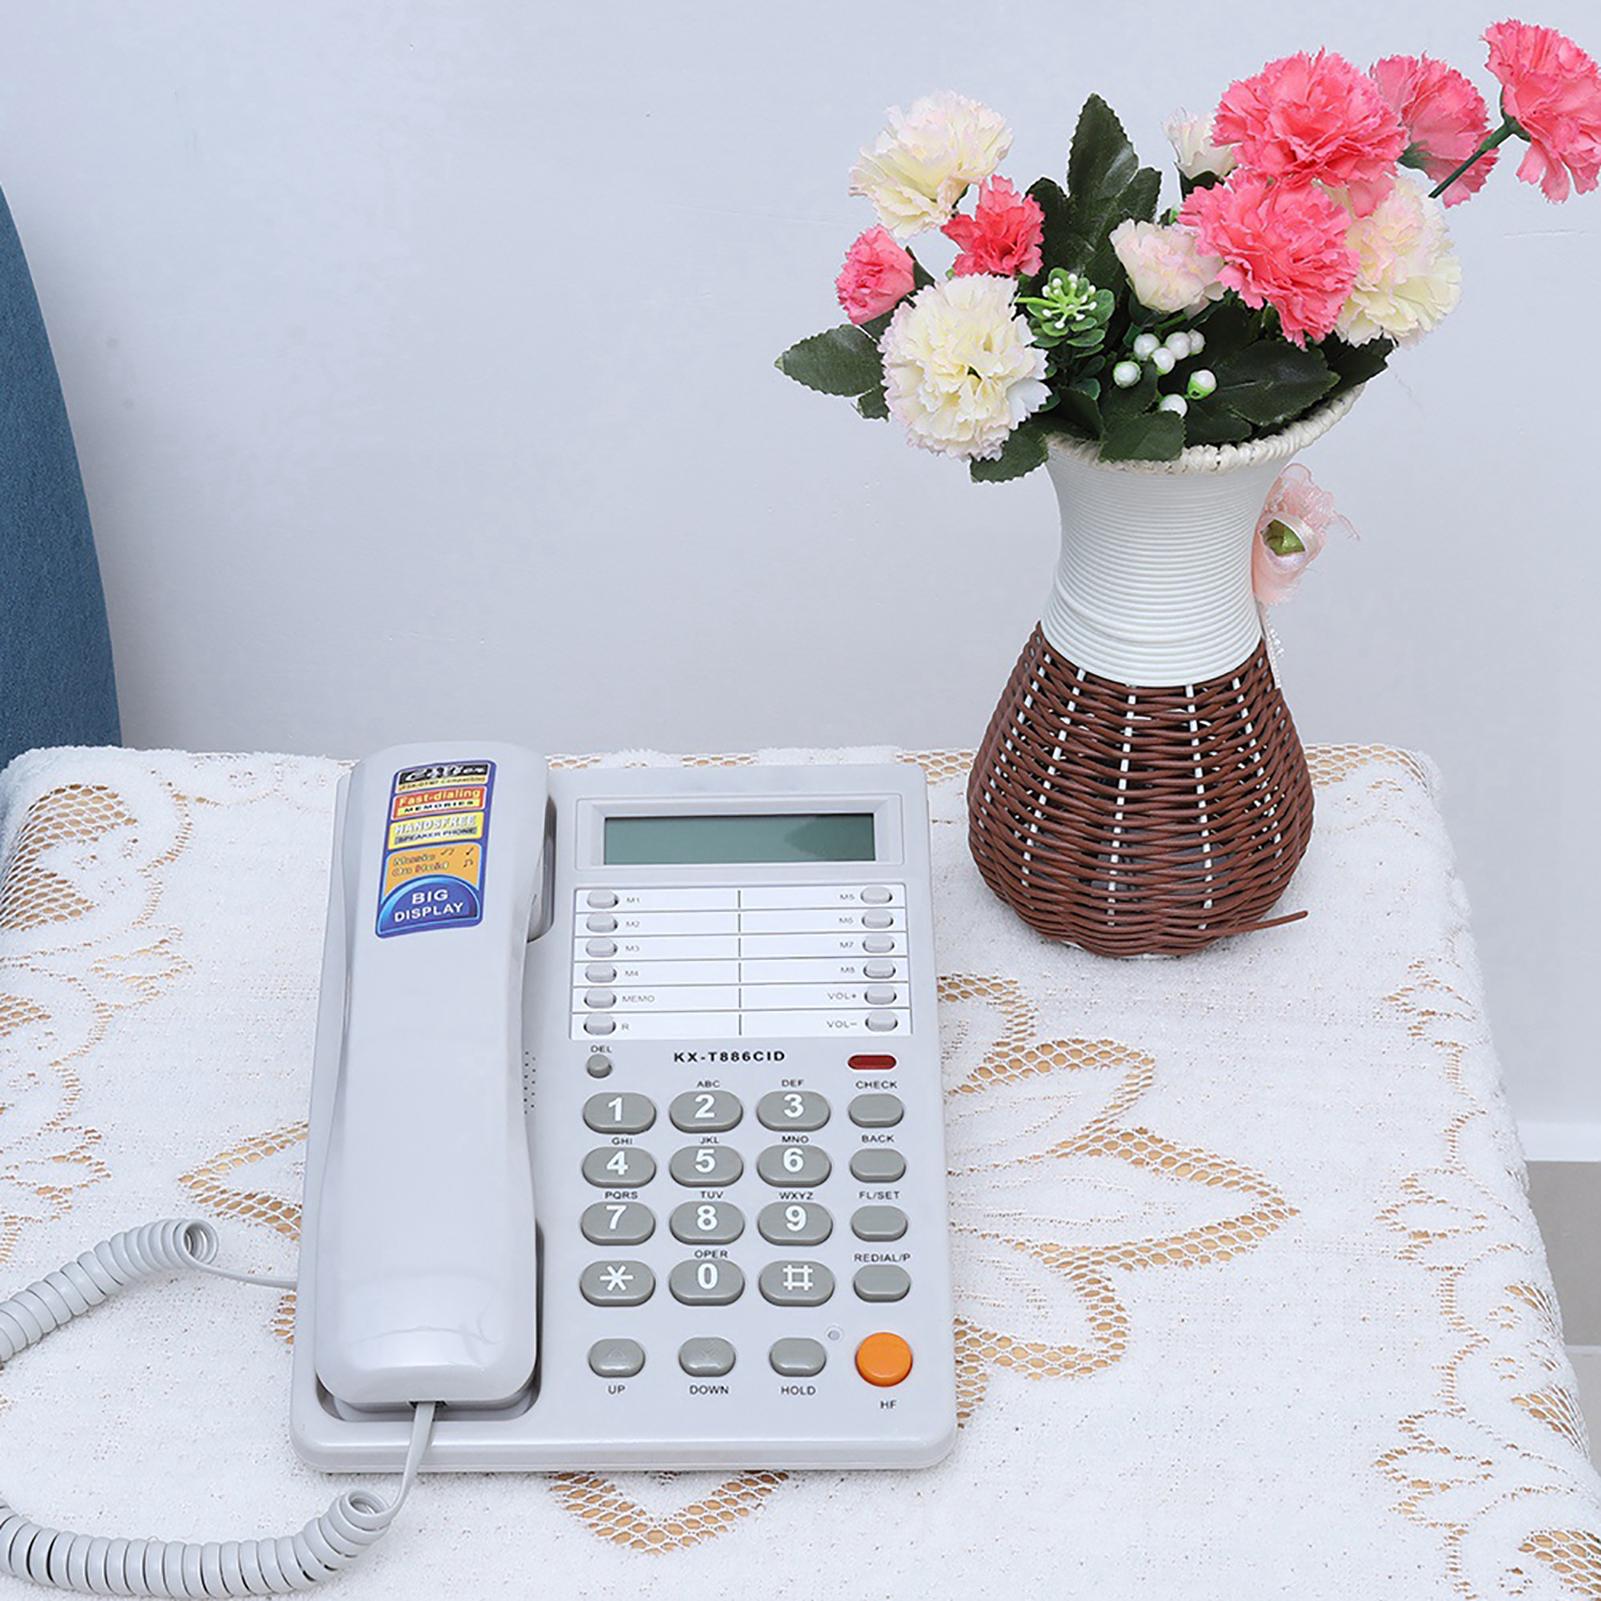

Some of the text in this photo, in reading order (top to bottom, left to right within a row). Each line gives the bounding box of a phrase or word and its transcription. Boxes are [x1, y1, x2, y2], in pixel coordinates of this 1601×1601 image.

[400, 789, 480, 806] Fast-dialing
[404, 801, 474, 813] MEMORIES
[395, 815, 477, 834] HANDSFREE
[394, 827, 477, 845] SPEAKER PHONE
[411, 889, 448, 905] BIG
[394, 902, 463, 923] DISPLAY
[590, 1045, 612, 1053] DEL
[674, 1051, 785, 1062] KX-T886CID
[697, 1080, 721, 1088] ABC
[781, 1079, 804, 1087] DEF
[855, 1081, 898, 1089] CHECK
[608, 1097, 623, 1122] 1
[694, 1094, 716, 1118] 2
[783, 1093, 804, 1118] 3
[611, 1137, 633, 1145] GHI
[782, 1135, 809, 1143] MNO
[861, 1135, 895, 1143] BACK
[606, 1151, 629, 1175] 4
[695, 1148, 716, 1173] 5
[783, 1147, 804, 1172] 6
[604, 1191, 638, 1200] PQRS
[700, 1191, 724, 1199] TUV
[779, 1192, 814, 1200] WXYZ
[859, 1191, 900, 1200] FL/SET
[606, 1205, 627, 1230] 7
[697, 1205, 718, 1230] 8
[785, 1205, 806, 1231] 9
[694, 1250, 728, 1258] OPER
[854, 1253, 911, 1262] REDIAL/P
[697, 1263, 718, 1289] 0
[608, 1385, 626, 1394] UP
[689, 1385, 729, 1395] DOWN
[781, 1385, 816, 1395] HOLD
[880, 1400, 897, 1409] HF
